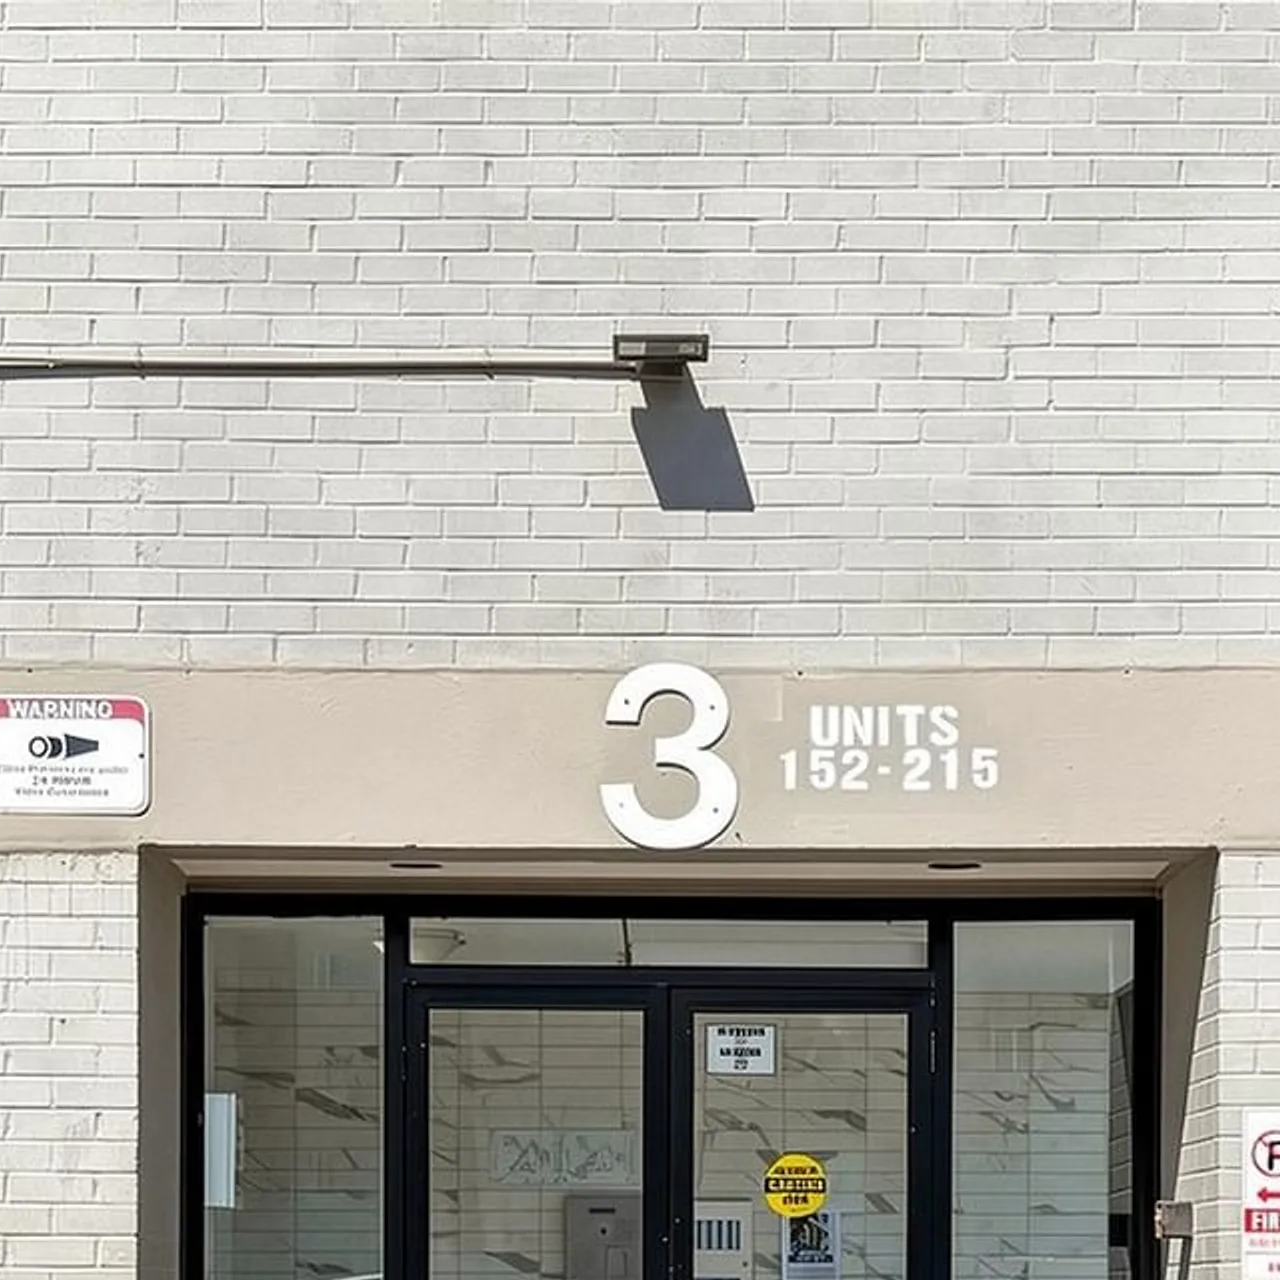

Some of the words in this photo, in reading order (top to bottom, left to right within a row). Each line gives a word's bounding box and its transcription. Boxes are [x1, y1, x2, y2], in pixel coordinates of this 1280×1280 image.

[9, 699, 114, 720] WARNING
[809, 704, 960, 748] UNITS
[599, 662, 739, 850] 3
[779, 748, 999, 791] 152-215
